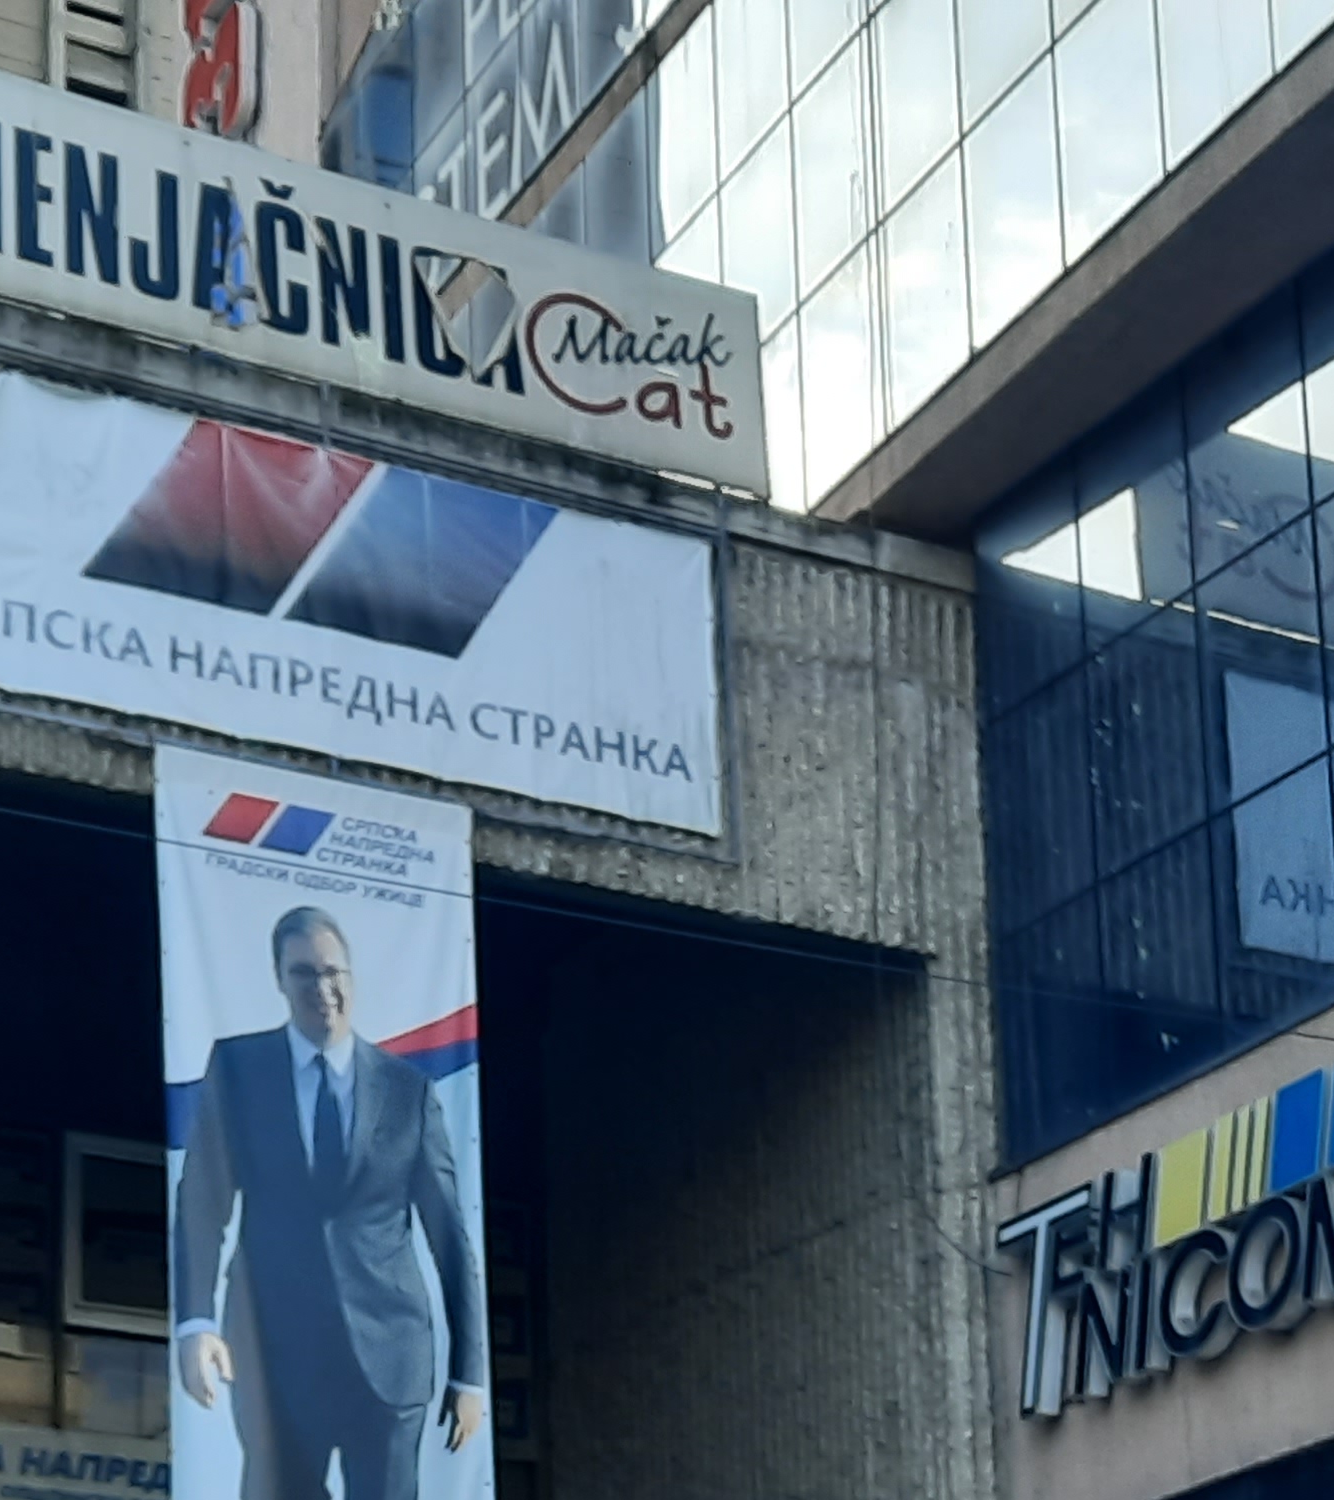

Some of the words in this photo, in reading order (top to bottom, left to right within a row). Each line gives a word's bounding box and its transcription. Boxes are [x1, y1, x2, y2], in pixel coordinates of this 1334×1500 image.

[551, 312, 734, 368] Mačak
[525, 292, 734, 440] Cat
[168, 635, 457, 734] НАПРЕДНА
[468, 701, 693, 782] СТРАНКА
[340, 816, 417, 843] СРПСКА
[315, 848, 408, 878] СТРАНКА
[328, 831, 435, 865] НАПРЕДНА
[204, 850, 288, 882] ГРАДСКИ
